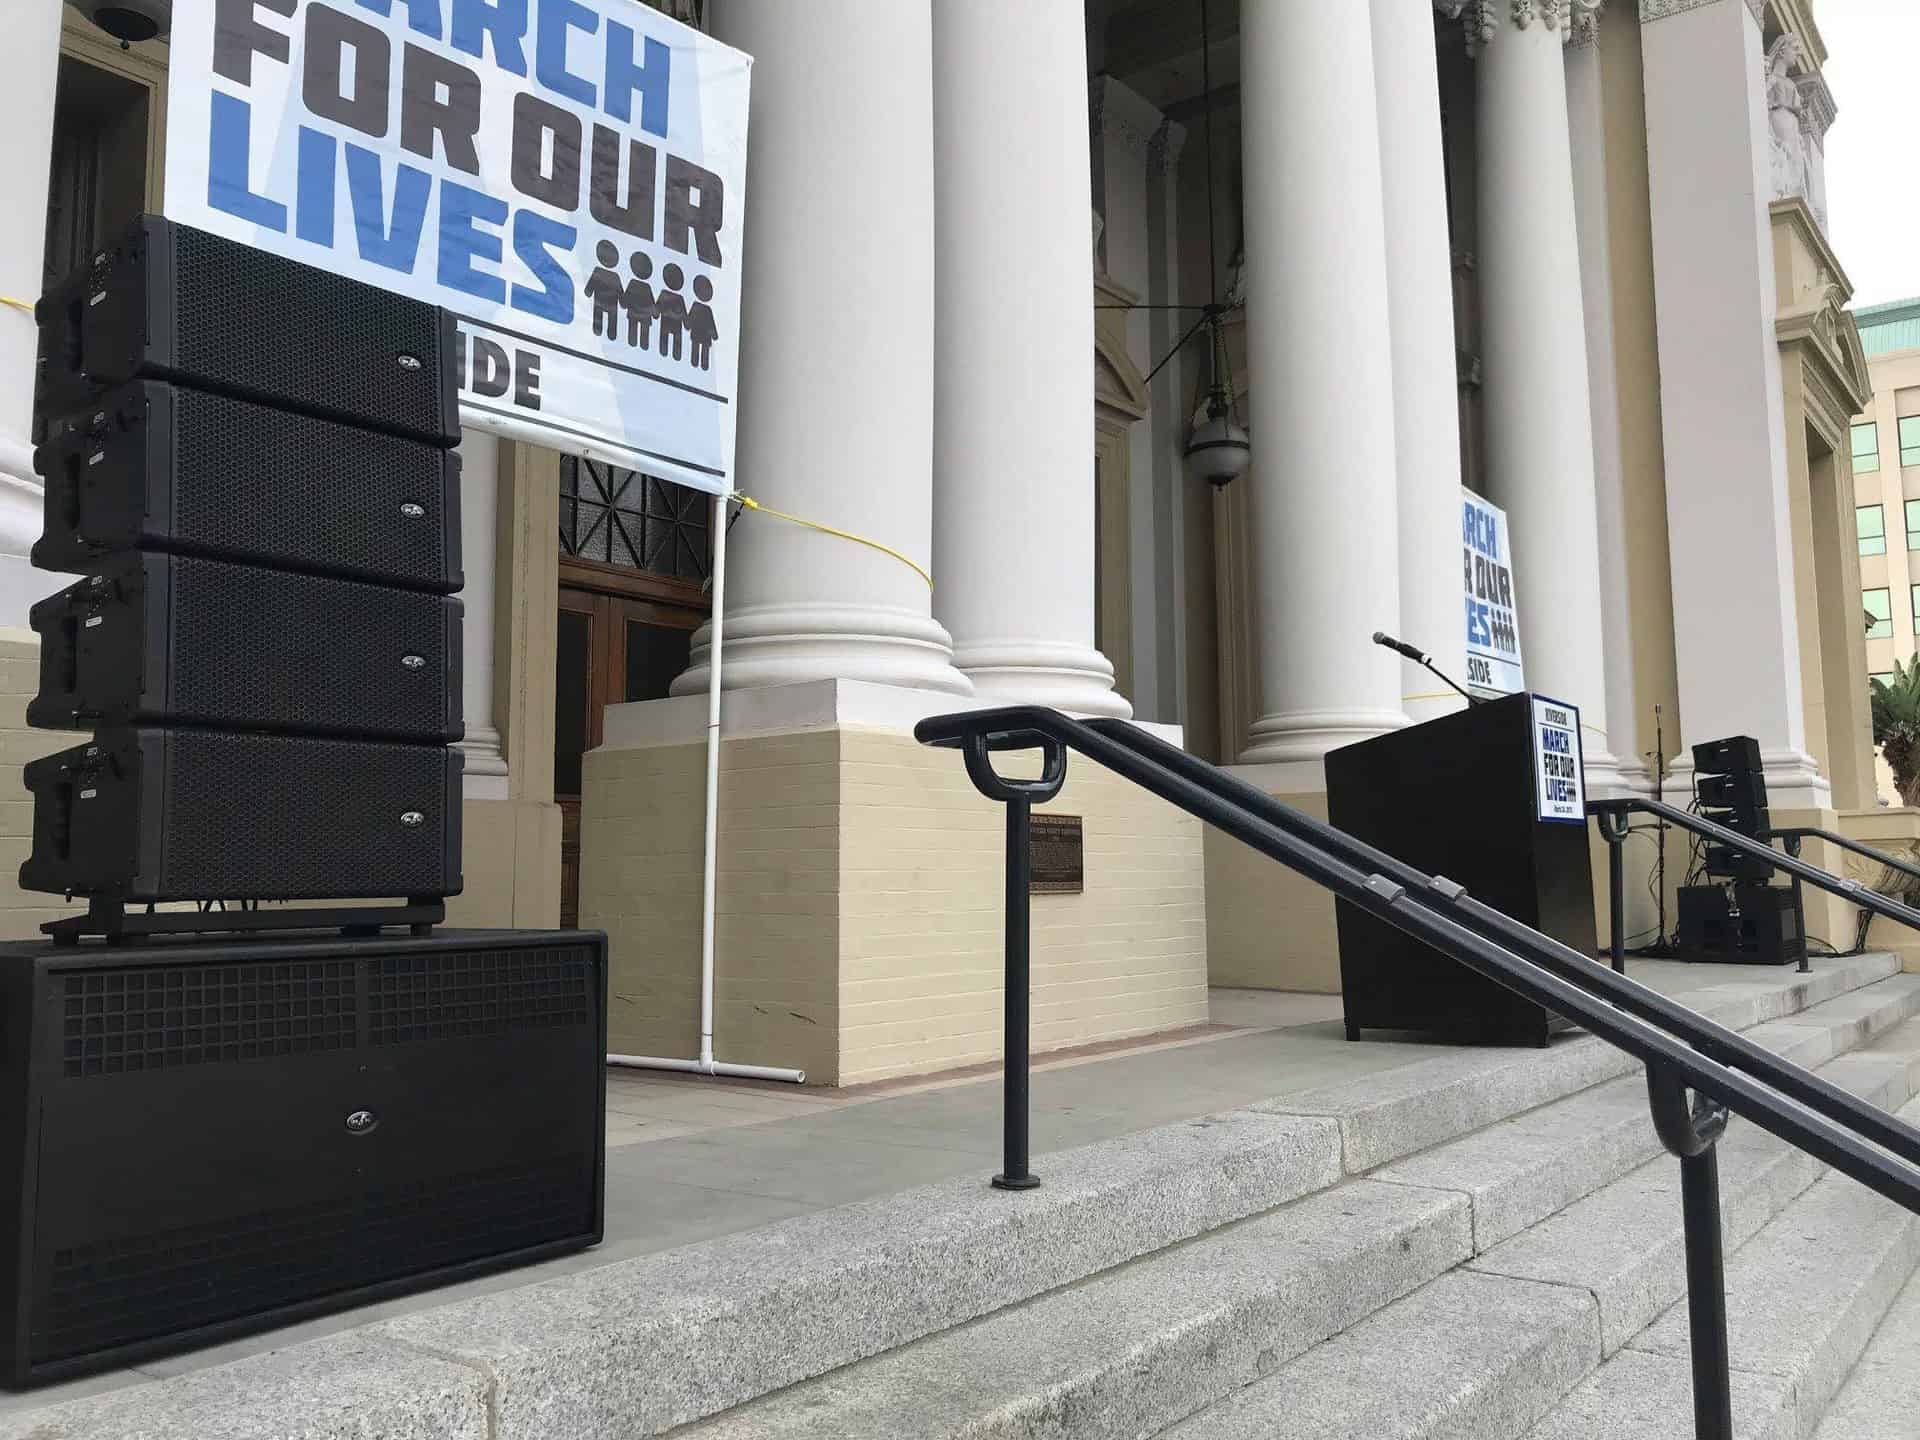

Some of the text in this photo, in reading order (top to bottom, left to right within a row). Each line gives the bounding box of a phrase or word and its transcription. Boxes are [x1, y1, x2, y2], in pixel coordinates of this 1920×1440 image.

[355, 0, 670, 138] RCH
[213, 0, 724, 268] FOR OUR
[207, 88, 577, 325] LIVES
[1463, 501, 1497, 559] RCH
[1475, 554, 1512, 609] OUR
[1465, 597, 1491, 648] ES
[1467, 657, 1492, 685] SIDE
[1542, 727, 1570, 754] MARCH
[1543, 752, 1575, 779] FOR OUR
[1545, 777, 1568, 802] LIVES
